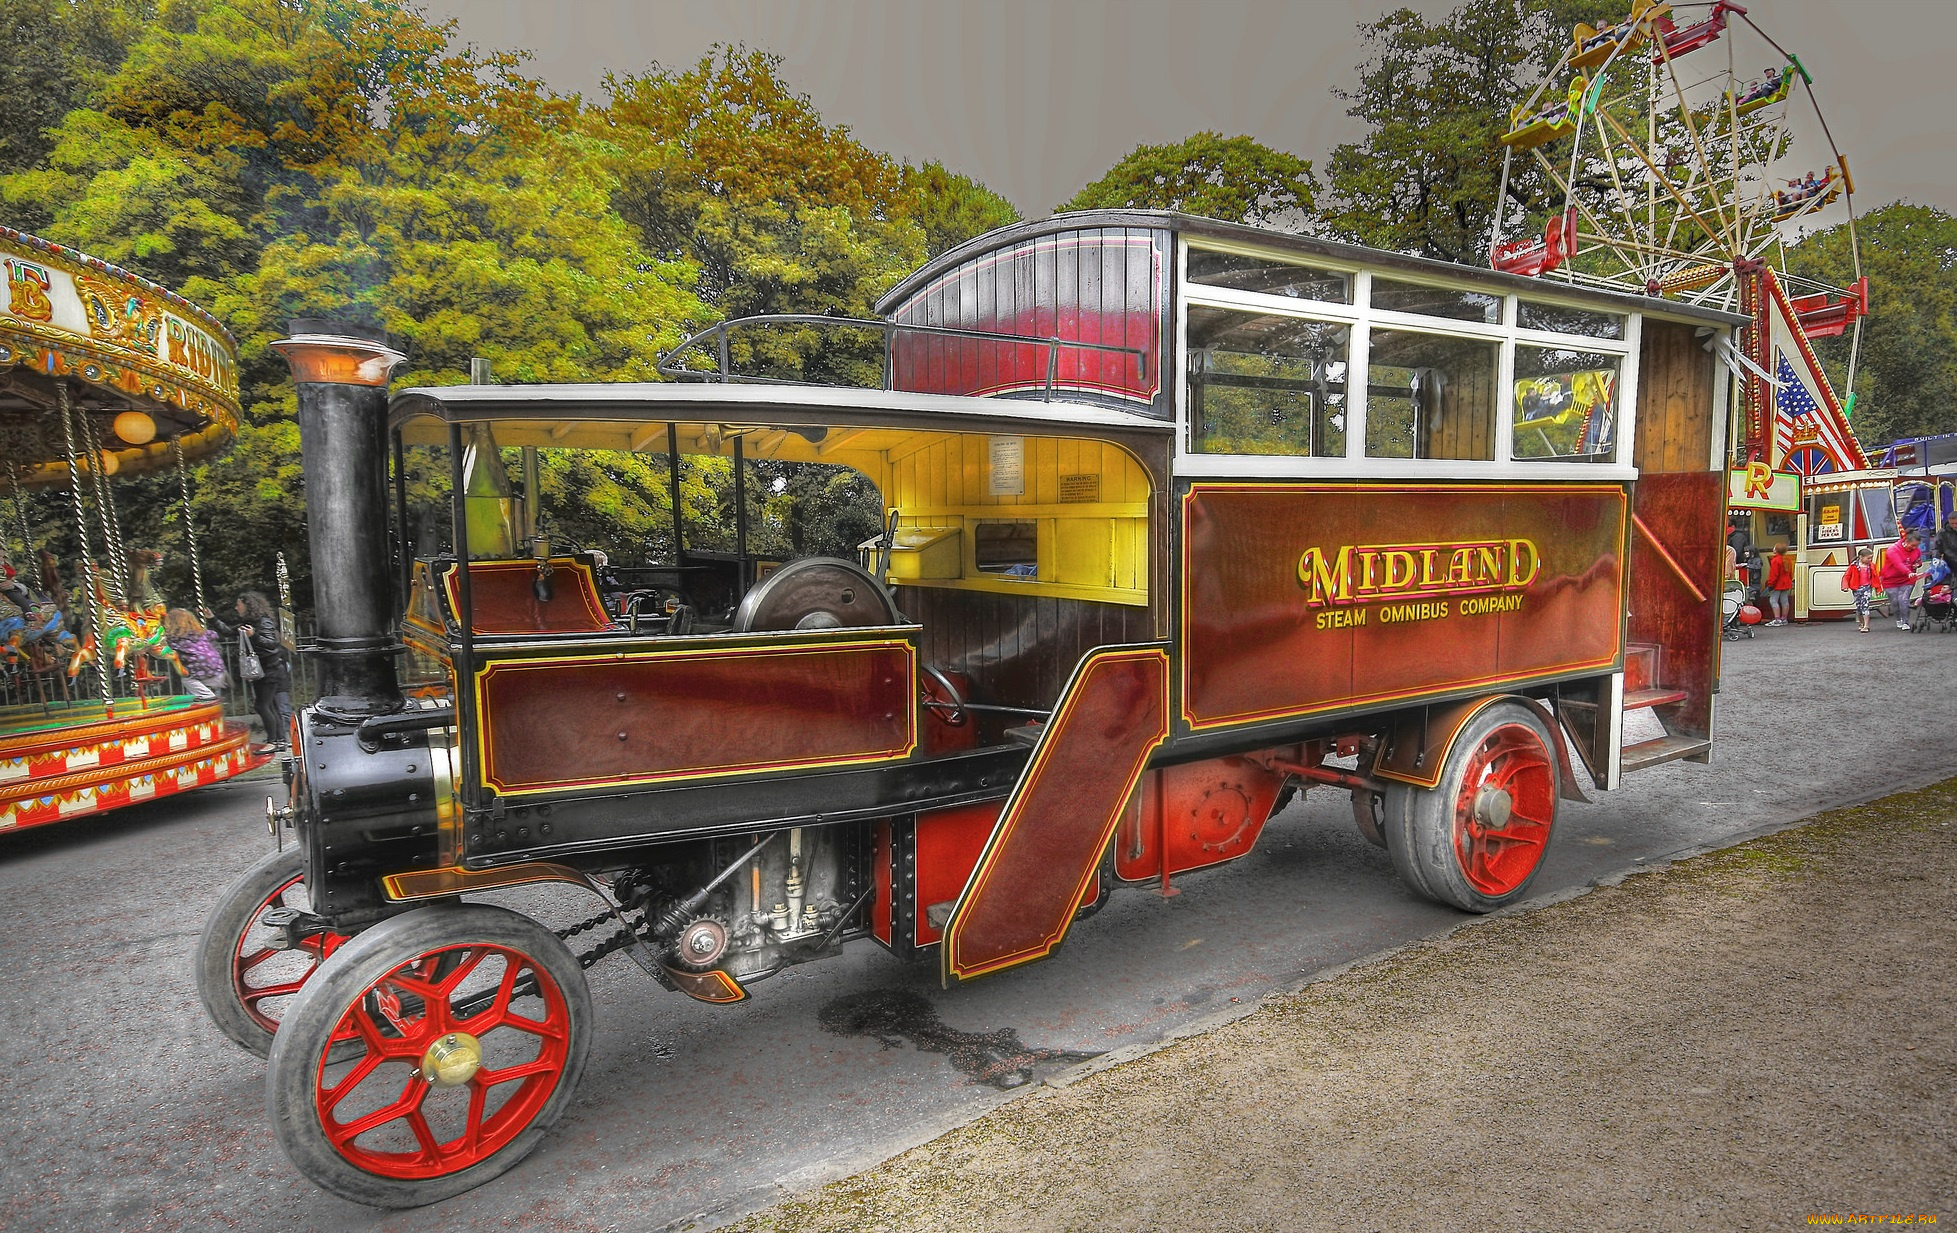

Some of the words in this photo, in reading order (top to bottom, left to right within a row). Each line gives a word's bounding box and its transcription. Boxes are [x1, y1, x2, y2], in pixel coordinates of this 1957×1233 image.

[1298, 538, 1541, 606] MIDLAND
[1316, 608, 1367, 629] STEAM
[1379, 601, 1449, 623] OMNIBUS
[1460, 594, 1524, 616] COMPANY
